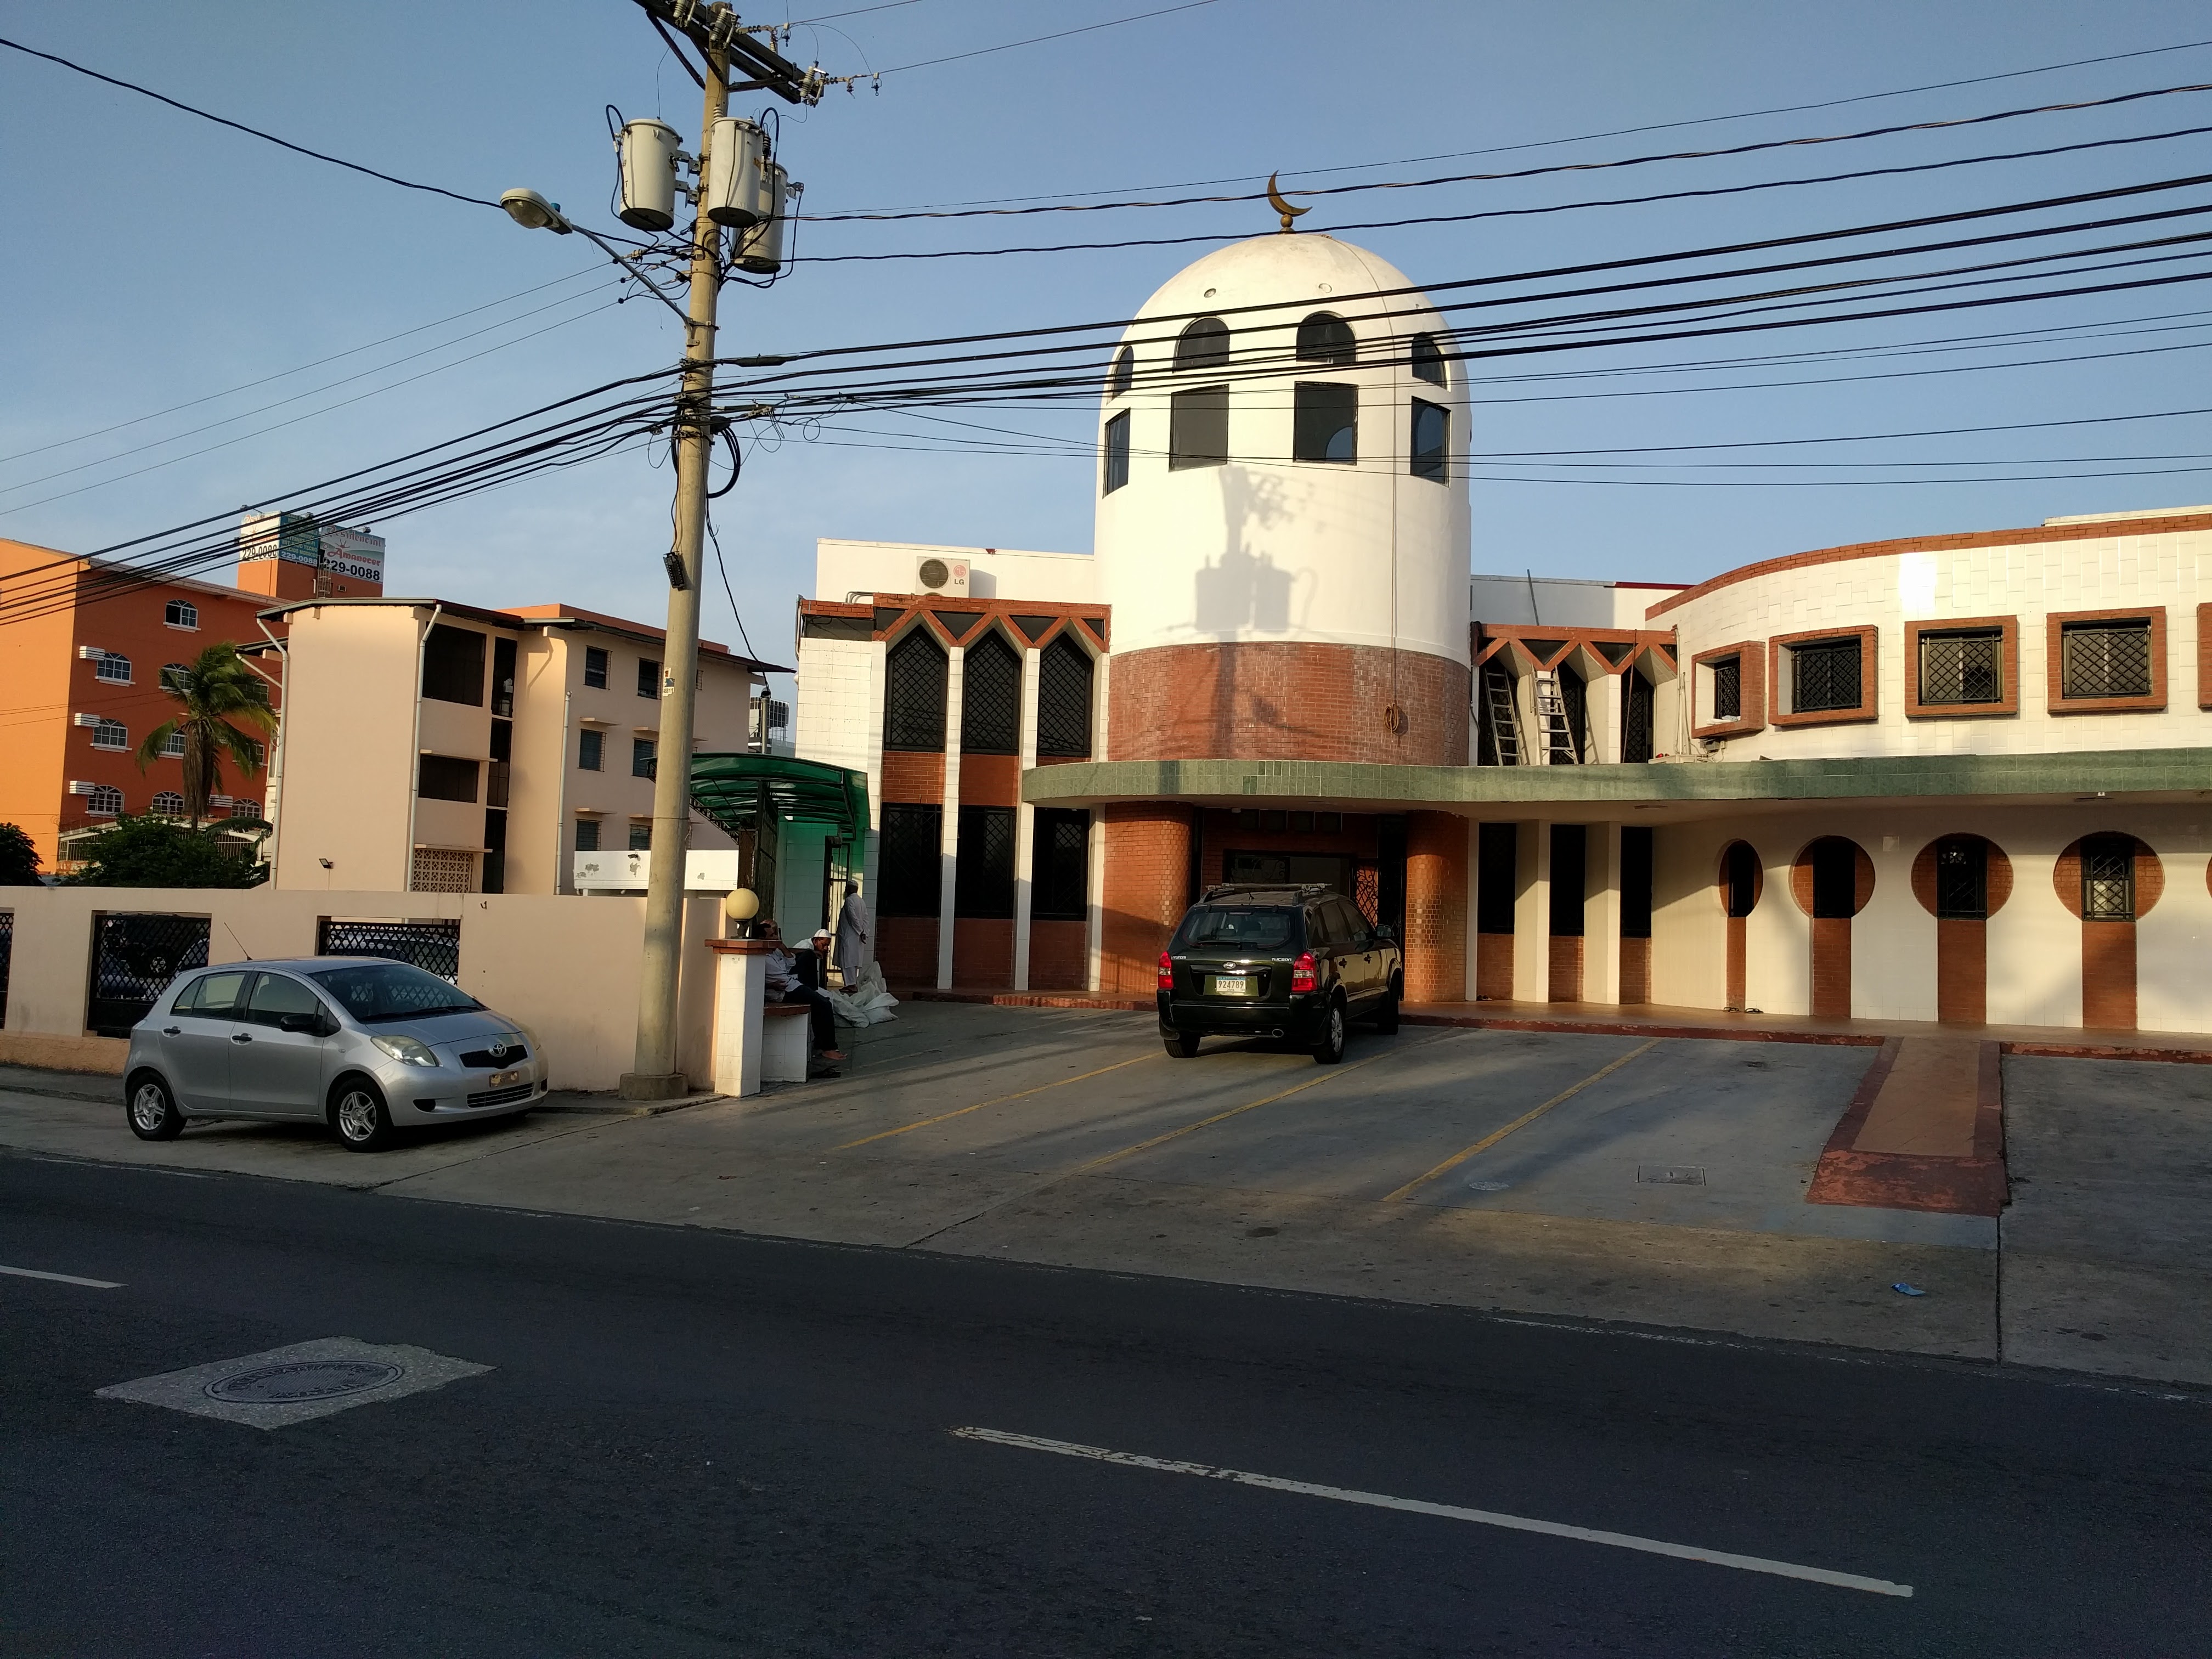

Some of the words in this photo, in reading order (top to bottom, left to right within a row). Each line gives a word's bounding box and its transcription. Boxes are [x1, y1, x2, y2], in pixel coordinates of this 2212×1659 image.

[281, 551, 318, 565] 229-0088
[327, 547, 381, 566] Amanecer
[1218, 980, 1244, 989] 924789
